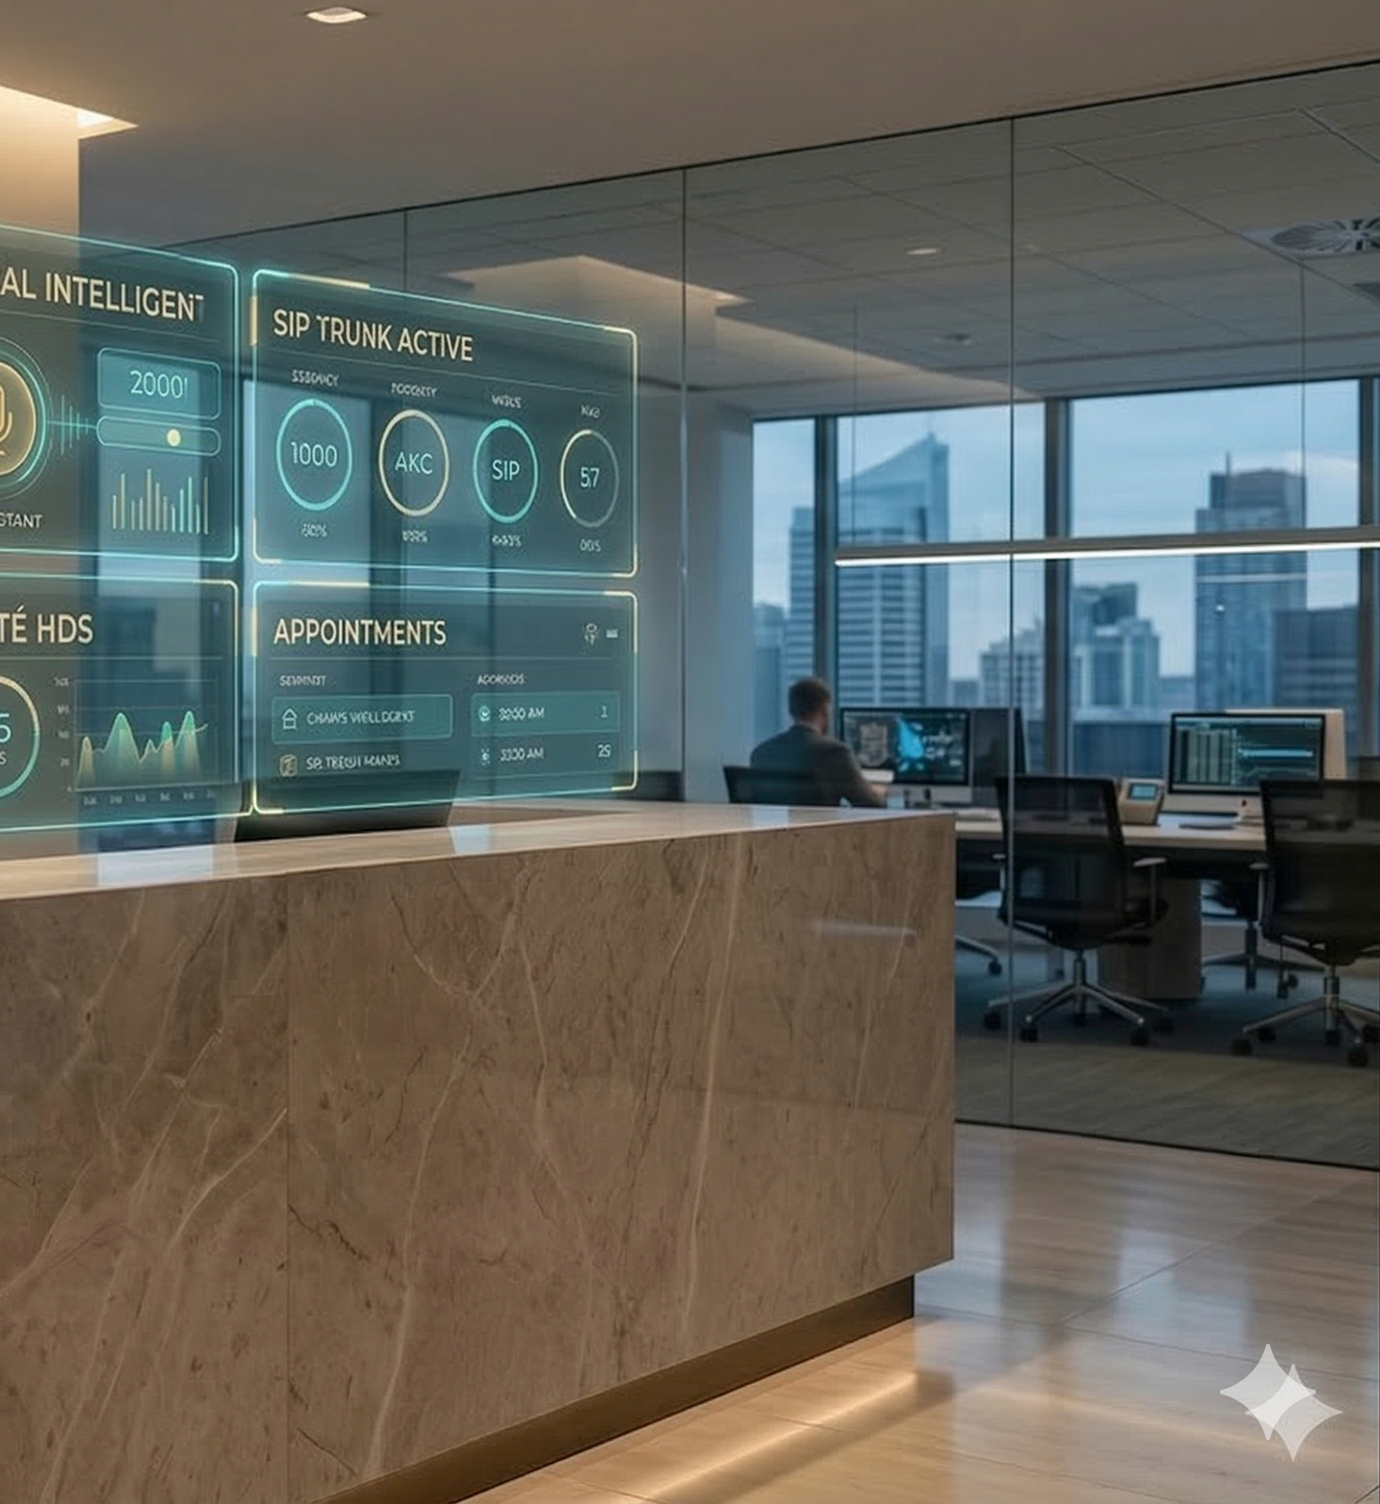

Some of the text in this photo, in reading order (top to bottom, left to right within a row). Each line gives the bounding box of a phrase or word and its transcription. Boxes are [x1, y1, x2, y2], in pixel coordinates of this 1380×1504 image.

[273, 308, 473, 362] SIP TRUNK ACTIVE
[291, 441, 338, 468] 1000
[395, 452, 433, 475] AKC
[492, 460, 520, 481] SIP
[36, 614, 94, 644] HDS
[273, 618, 446, 645] APPOINTMENTS
